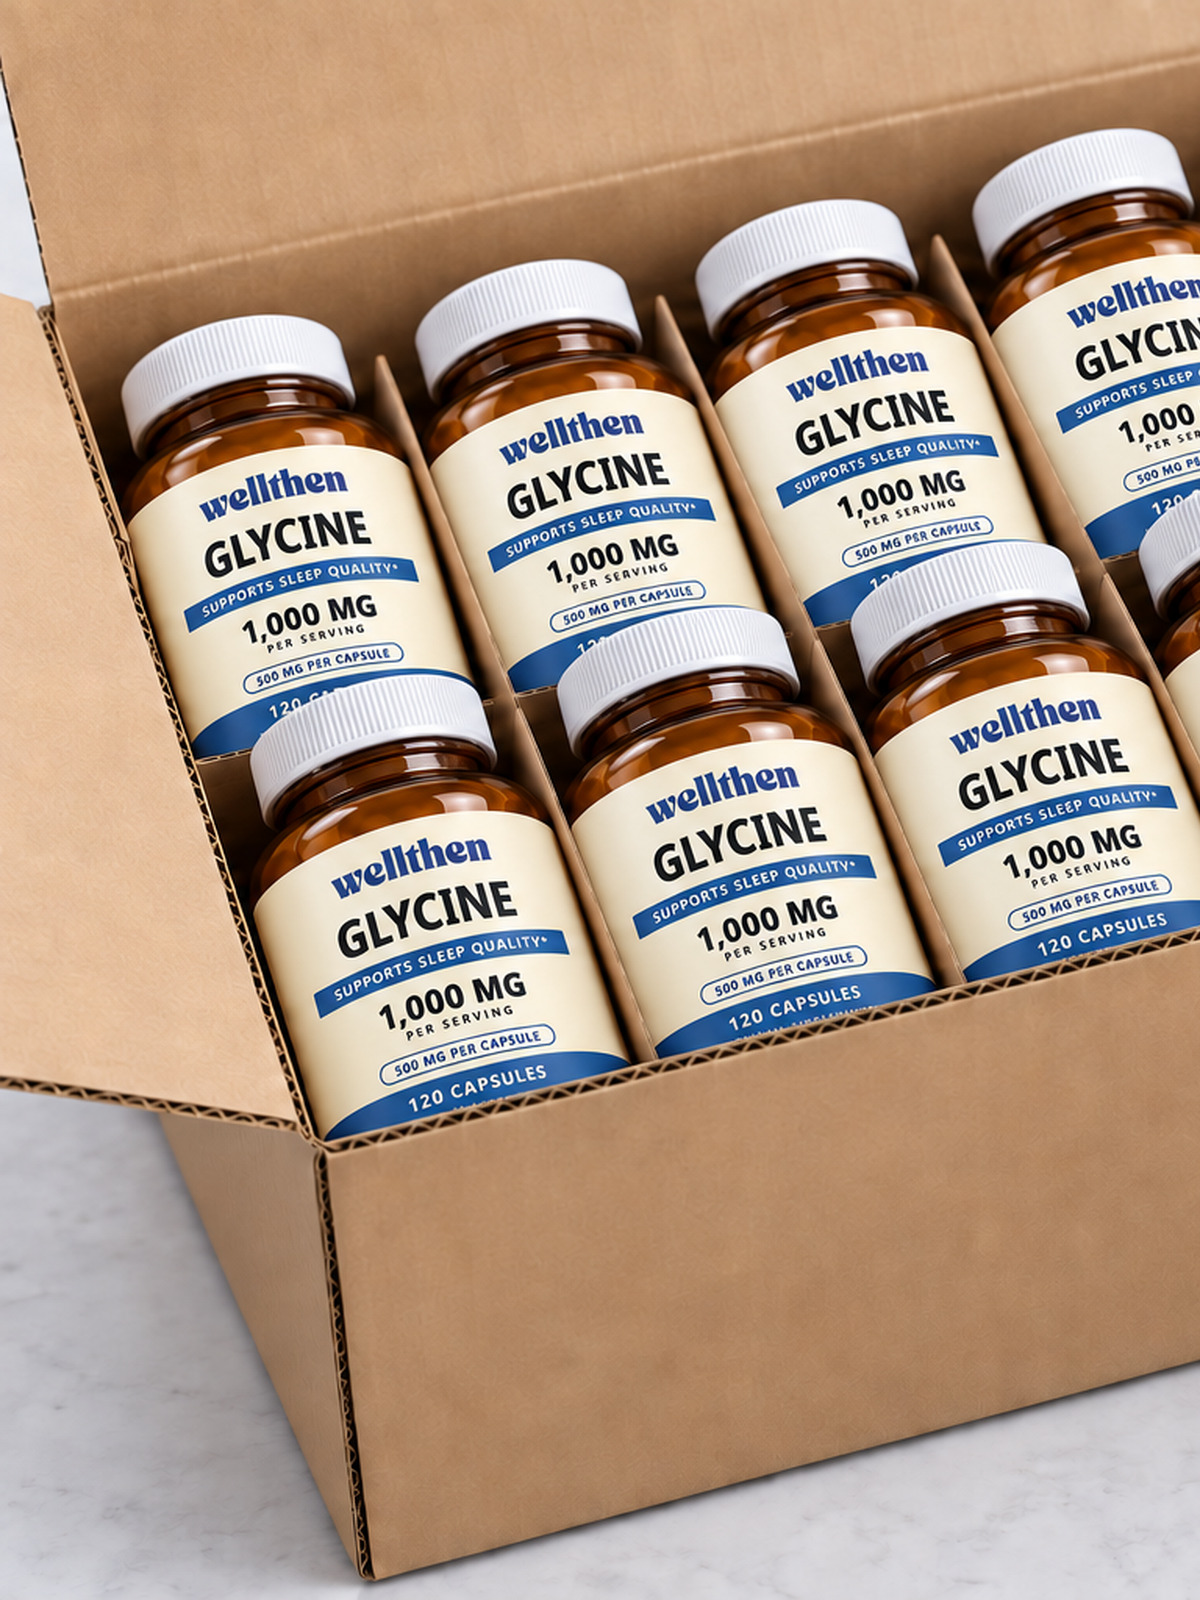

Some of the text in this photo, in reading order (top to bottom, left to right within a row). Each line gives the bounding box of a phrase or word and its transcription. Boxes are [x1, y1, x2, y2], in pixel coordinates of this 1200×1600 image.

[786, 349, 929, 402] wellthen
[1075, 382, 1147, 419] SUPPORTS
[1152, 371, 1193, 389] SLEEP
[499, 412, 644, 465] wellthen
[795, 390, 955, 456] GLYCINE
[1118, 403, 1195, 443] 1,000
[1145, 438, 1171, 452] PER
[507, 453, 670, 519] GLYCINE
[795, 457, 865, 494] SUPPORTS
[870, 445, 911, 465] SLEEP
[199, 468, 348, 522] wellthen
[837, 470, 966, 519] 1,000 MG
[863, 498, 956, 528] PER SERVING
[205, 511, 372, 578] GLYCINE
[506, 521, 576, 557] SUPPORTS
[581, 509, 623, 528] SLEEP
[881, 537, 901, 552] MG
[547, 534, 679, 583] 1,000 MG
[572, 563, 668, 593] PER SERVING
[202, 580, 274, 617] SUPPORTS
[279, 568, 322, 587] SLEEP
[589, 603, 610, 616] MG
[613, 596, 637, 609] PER
[242, 595, 377, 644] 1,000 MG
[267, 624, 364, 653] PER SERVING
[282, 664, 303, 678] MG
[307, 657, 332, 671] PER
[949, 698, 1102, 754] wellthen
[646, 766, 800, 824] wellthen
[959, 738, 1130, 811] GLYCINE
[654, 807, 827, 882] GLYCINE
[958, 813, 1034, 851] SUPPORTS
[1038, 799, 1082, 820] SLEEP
[331, 838, 492, 899] wellthen
[1003, 825, 1142, 878] 1,000 MG
[1031, 856, 1130, 888] PER SERVING
[338, 881, 518, 958] GLYCINE
[653, 884, 728, 924] SUPPORTS
[733, 870, 778, 891] SLEEP
[1022, 880, 1158, 923] 500 MG PER CAPSULE
[697, 895, 838, 951] 1,000 MG
[724, 928, 826, 962] PER SERVING
[1038, 935, 1072, 956] 120
[1078, 913, 1167, 943] CAPSULES
[334, 960, 413, 1001] SUPPORTS
[418, 946, 465, 968] SLEEP
[715, 952, 854, 997] 500 MG PER CAPSULE
[379, 972, 527, 1030] 1,000 MG
[406, 1005, 513, 1041] PER SERVING
[729, 1009, 763, 1030] 120
[770, 985, 861, 1017] CAPSULES
[395, 1031, 541, 1077] 500 MG PER CAPSULE
[409, 1089, 443, 1112] 120
[451, 1065, 546, 1098] CAPSULES
